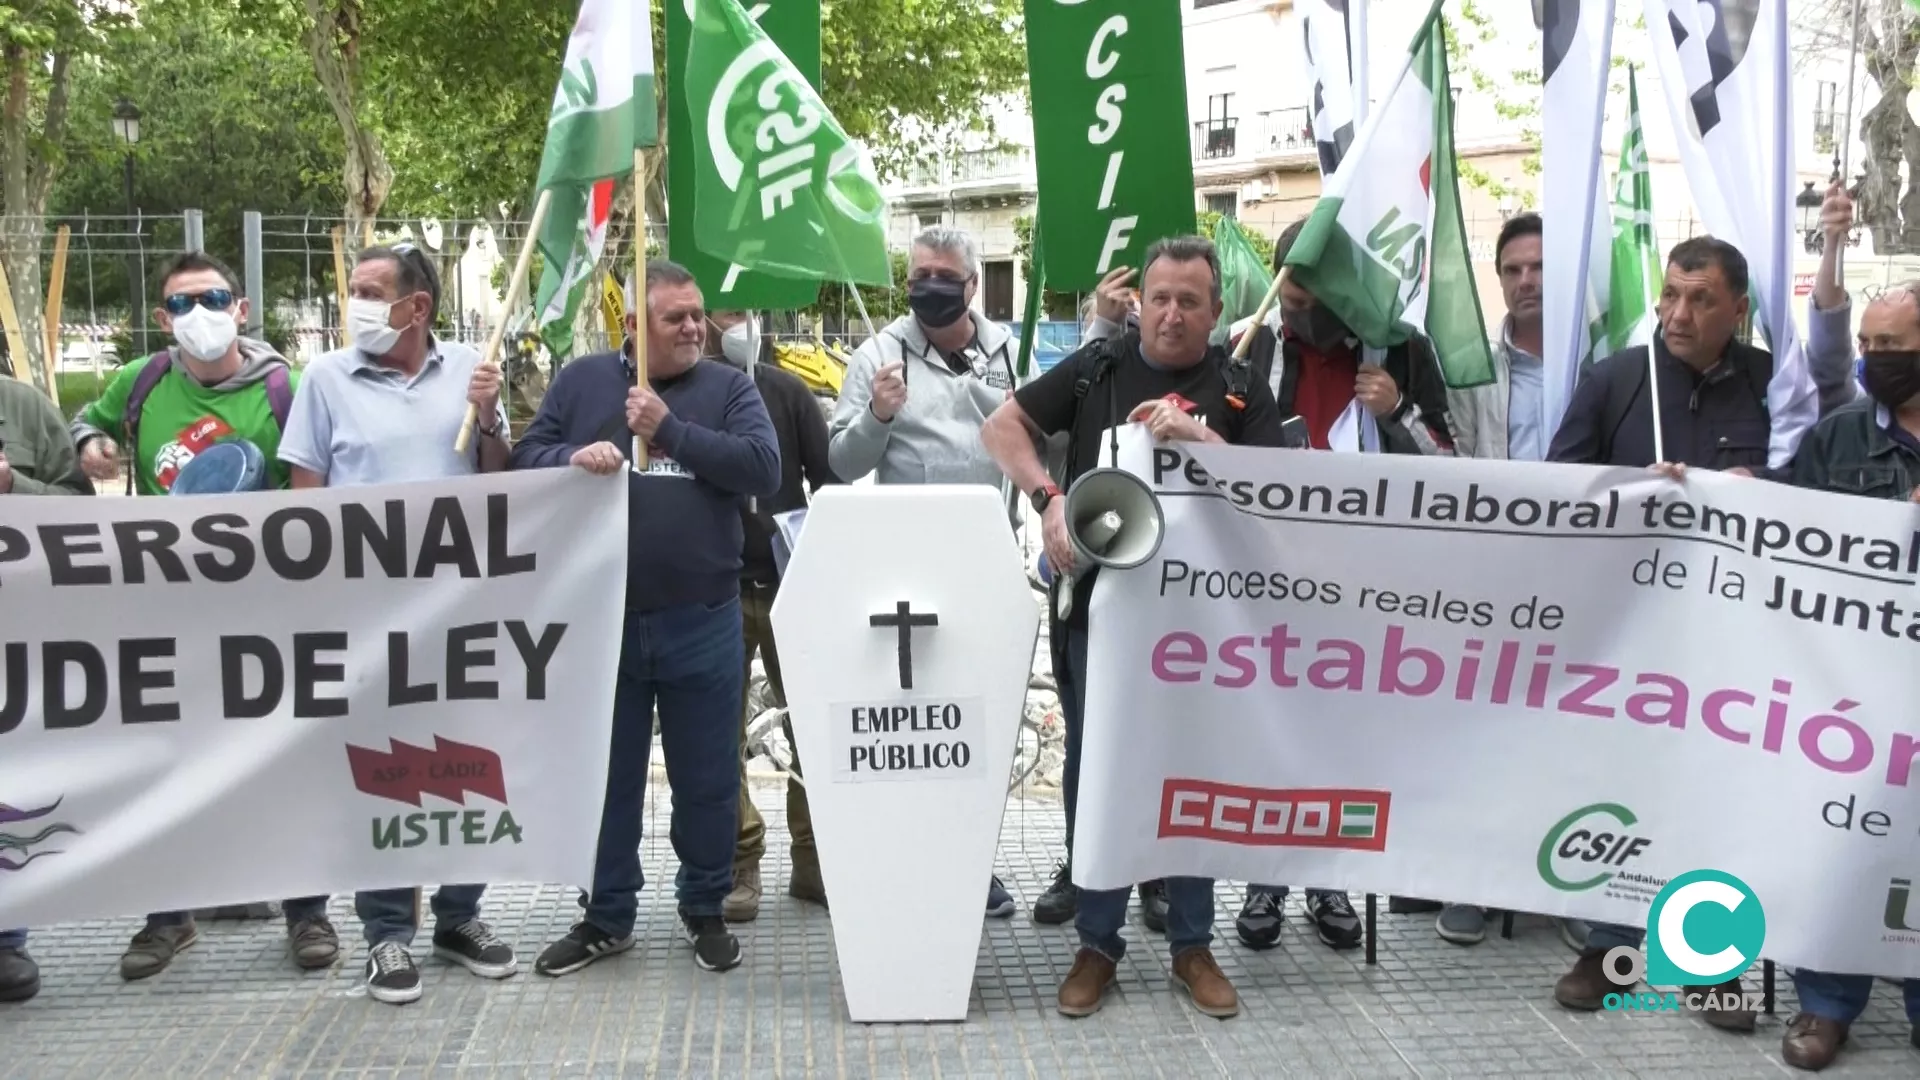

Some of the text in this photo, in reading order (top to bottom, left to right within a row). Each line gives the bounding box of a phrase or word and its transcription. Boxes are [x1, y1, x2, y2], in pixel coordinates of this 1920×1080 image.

[1085, 14, 1138, 274] CSIF
[1410, 480, 1619, 529] laboral
[1640, 495, 1920, 574] temporal
[1159, 559, 1565, 631] Procesos reales de
[1632, 548, 1688, 590] de
[1708, 555, 1745, 601] la
[220, 631, 349, 720] DE
[387, 619, 569, 708] LEY
[851, 703, 962, 734] EMPLEO
[850, 738, 971, 772] PÚBLICO
[371, 808, 524, 851] USTEA
[1169, 789, 1331, 837] CCOO
[1822, 793, 1892, 836] de
[1557, 828, 1653, 867] CSIF
